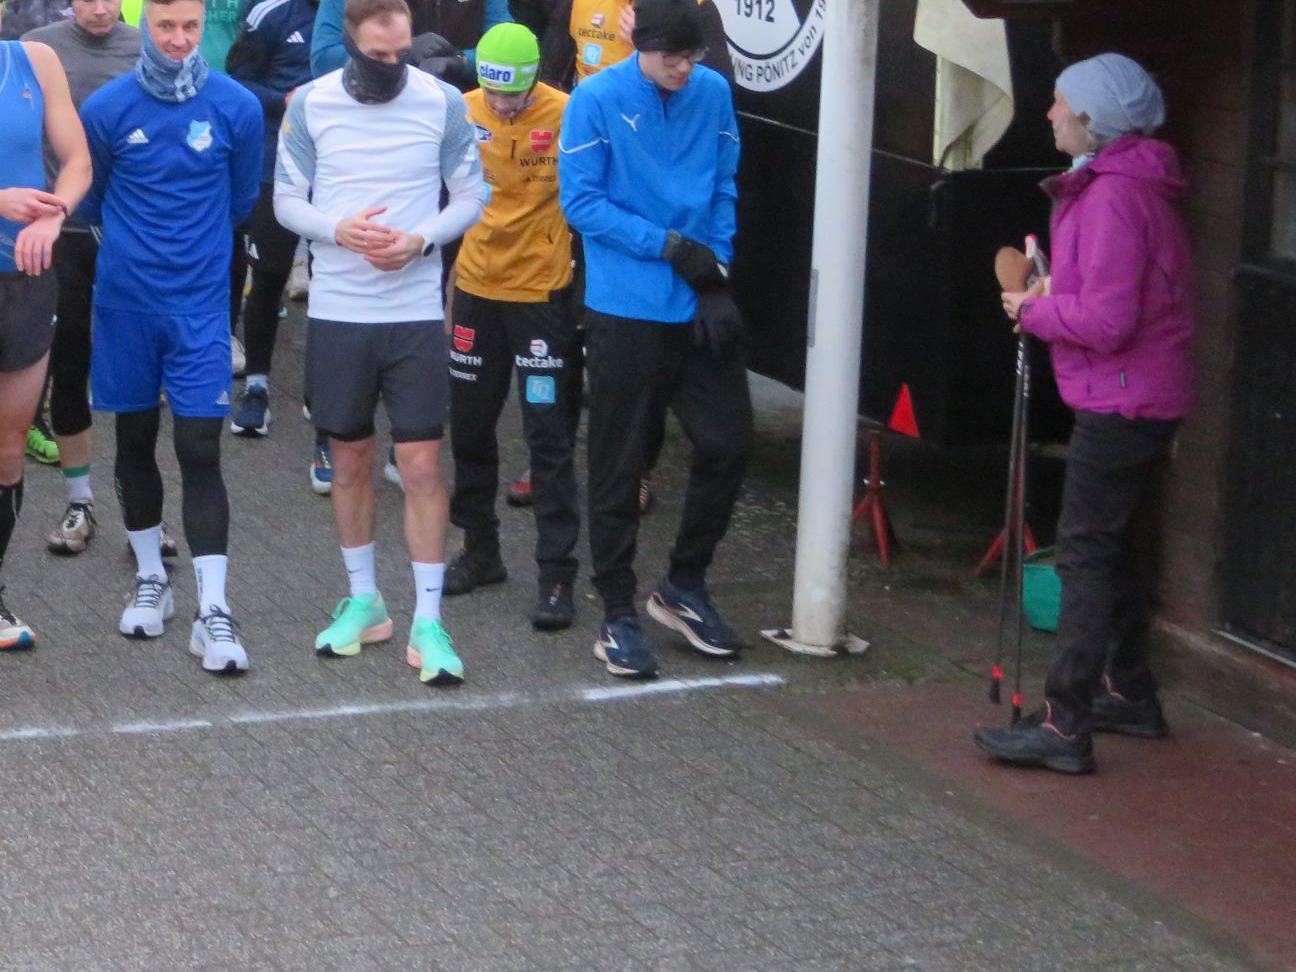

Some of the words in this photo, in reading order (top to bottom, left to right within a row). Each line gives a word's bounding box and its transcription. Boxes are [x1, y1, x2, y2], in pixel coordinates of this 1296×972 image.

[578, 26, 616, 42] tectake
[756, 51, 799, 83] PÖNITZ
[798, 26, 818, 57] von
[480, 64, 511, 82] claro
[515, 354, 564, 368] tectake
